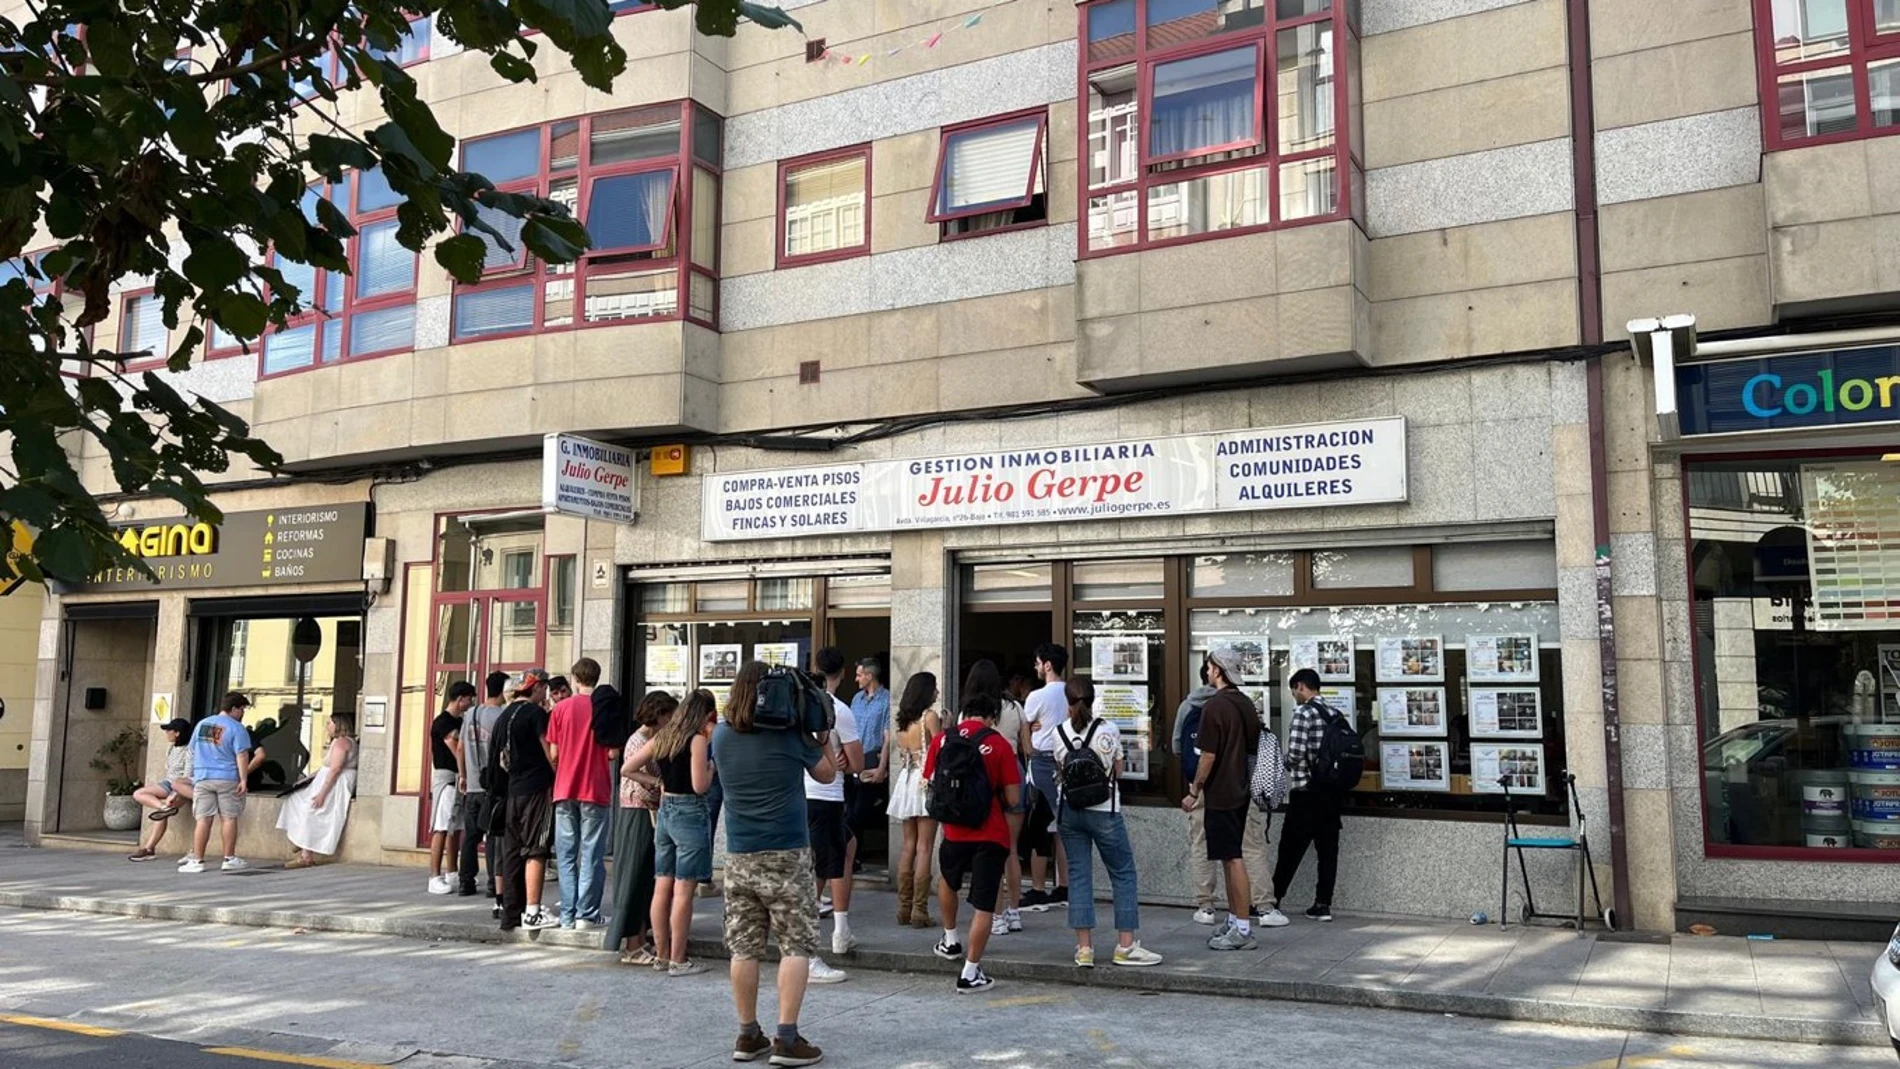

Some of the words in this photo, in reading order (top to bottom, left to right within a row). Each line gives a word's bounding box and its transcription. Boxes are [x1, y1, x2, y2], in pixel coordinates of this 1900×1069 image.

[1217, 429, 1374, 456] ADMINISTRACION
[561, 440, 571, 455] G.
[573, 443, 631, 468] INMOBILIARIA
[909, 456, 993, 475] GESTION
[1001, 443, 1155, 468] INMOBILIARIA
[561, 460, 592, 480] Julio
[594, 466, 629, 490] Gerpe
[1230, 454, 1362, 478] COMUNIDADES
[723, 474, 818, 493] COMPRA-VENTA
[823, 471, 860, 485] PISOS
[917, 473, 1014, 507] Julio
[1027, 468, 1144, 503] Gerpe
[1239, 479, 1353, 501] ALQUILERES
[725, 497, 763, 511] BAJOS
[766, 491, 857, 509] COMERCIALES
[1057, 500, 1171, 517] www.juliogerpe.es
[278, 511, 338, 524] INTERIORISMO
[732, 515, 776, 530] FINCAS
[779, 515, 787, 527] Y
[791, 511, 848, 527] SOLARES
[277, 529, 324, 542] REFORMAS
[276, 547, 314, 560] COCINAS
[274, 563, 304, 577] BAÑOS
